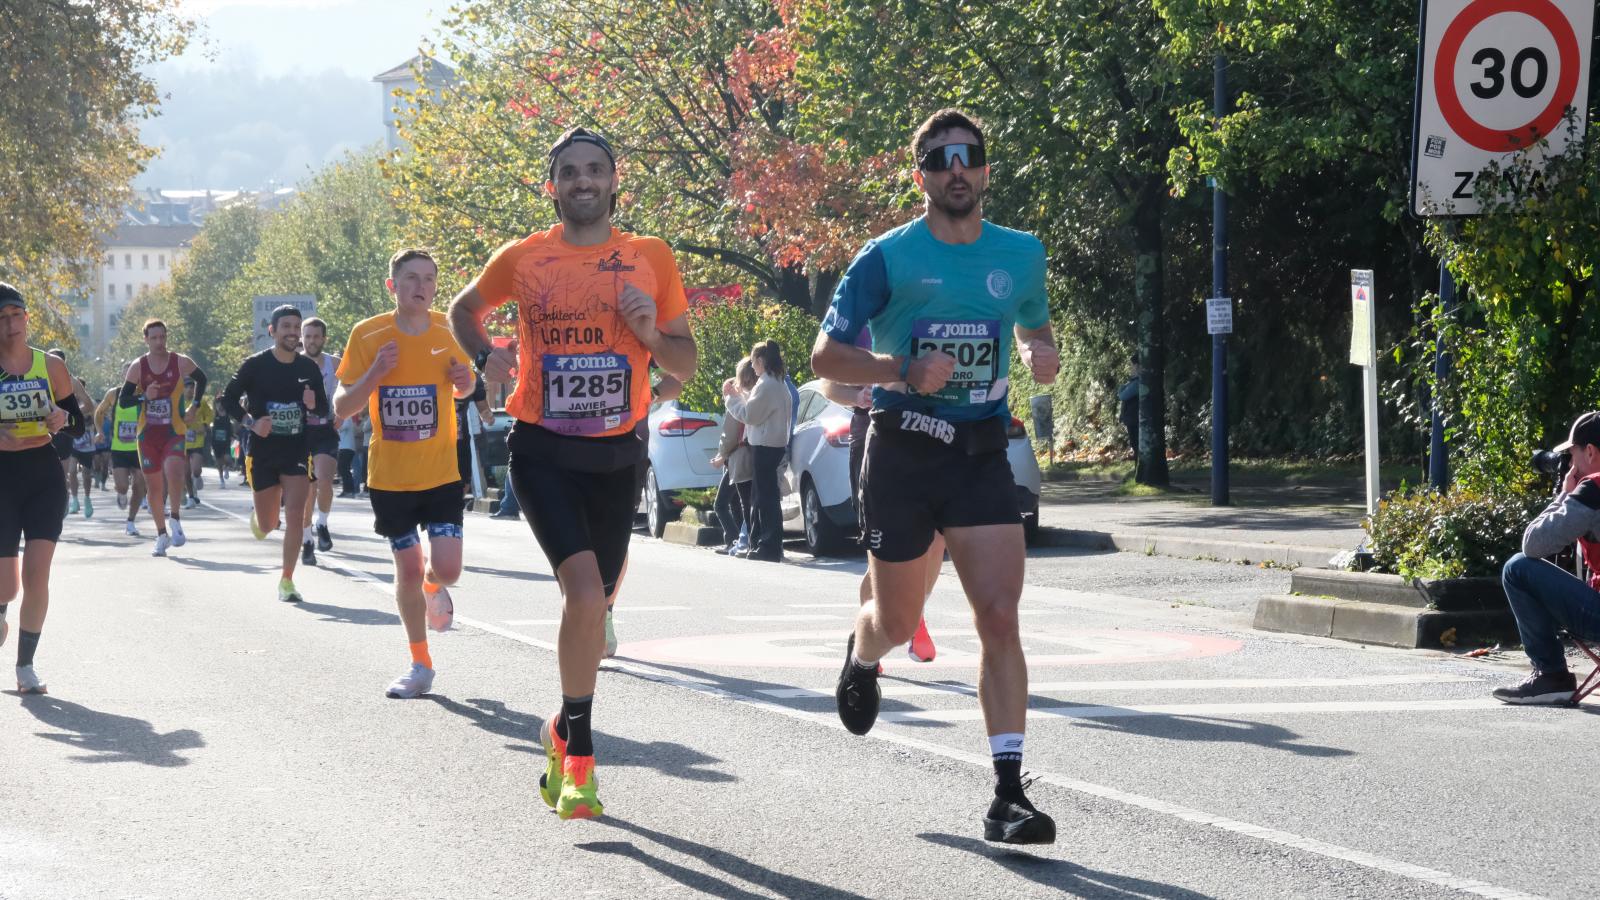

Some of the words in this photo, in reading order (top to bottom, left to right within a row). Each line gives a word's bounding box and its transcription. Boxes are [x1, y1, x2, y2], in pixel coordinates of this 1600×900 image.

[1470, 47, 1548, 99] 30
[1452, 170, 1547, 199] ZNA
[541, 327, 561, 345] LA
[565, 327, 604, 345] FLOR
[551, 372, 623, 398] 1285
[4, 391, 46, 411] 391
[384, 399, 433, 417] 1106
[568, 400, 607, 411] JAVIER
[270, 410, 300, 421] 2508
